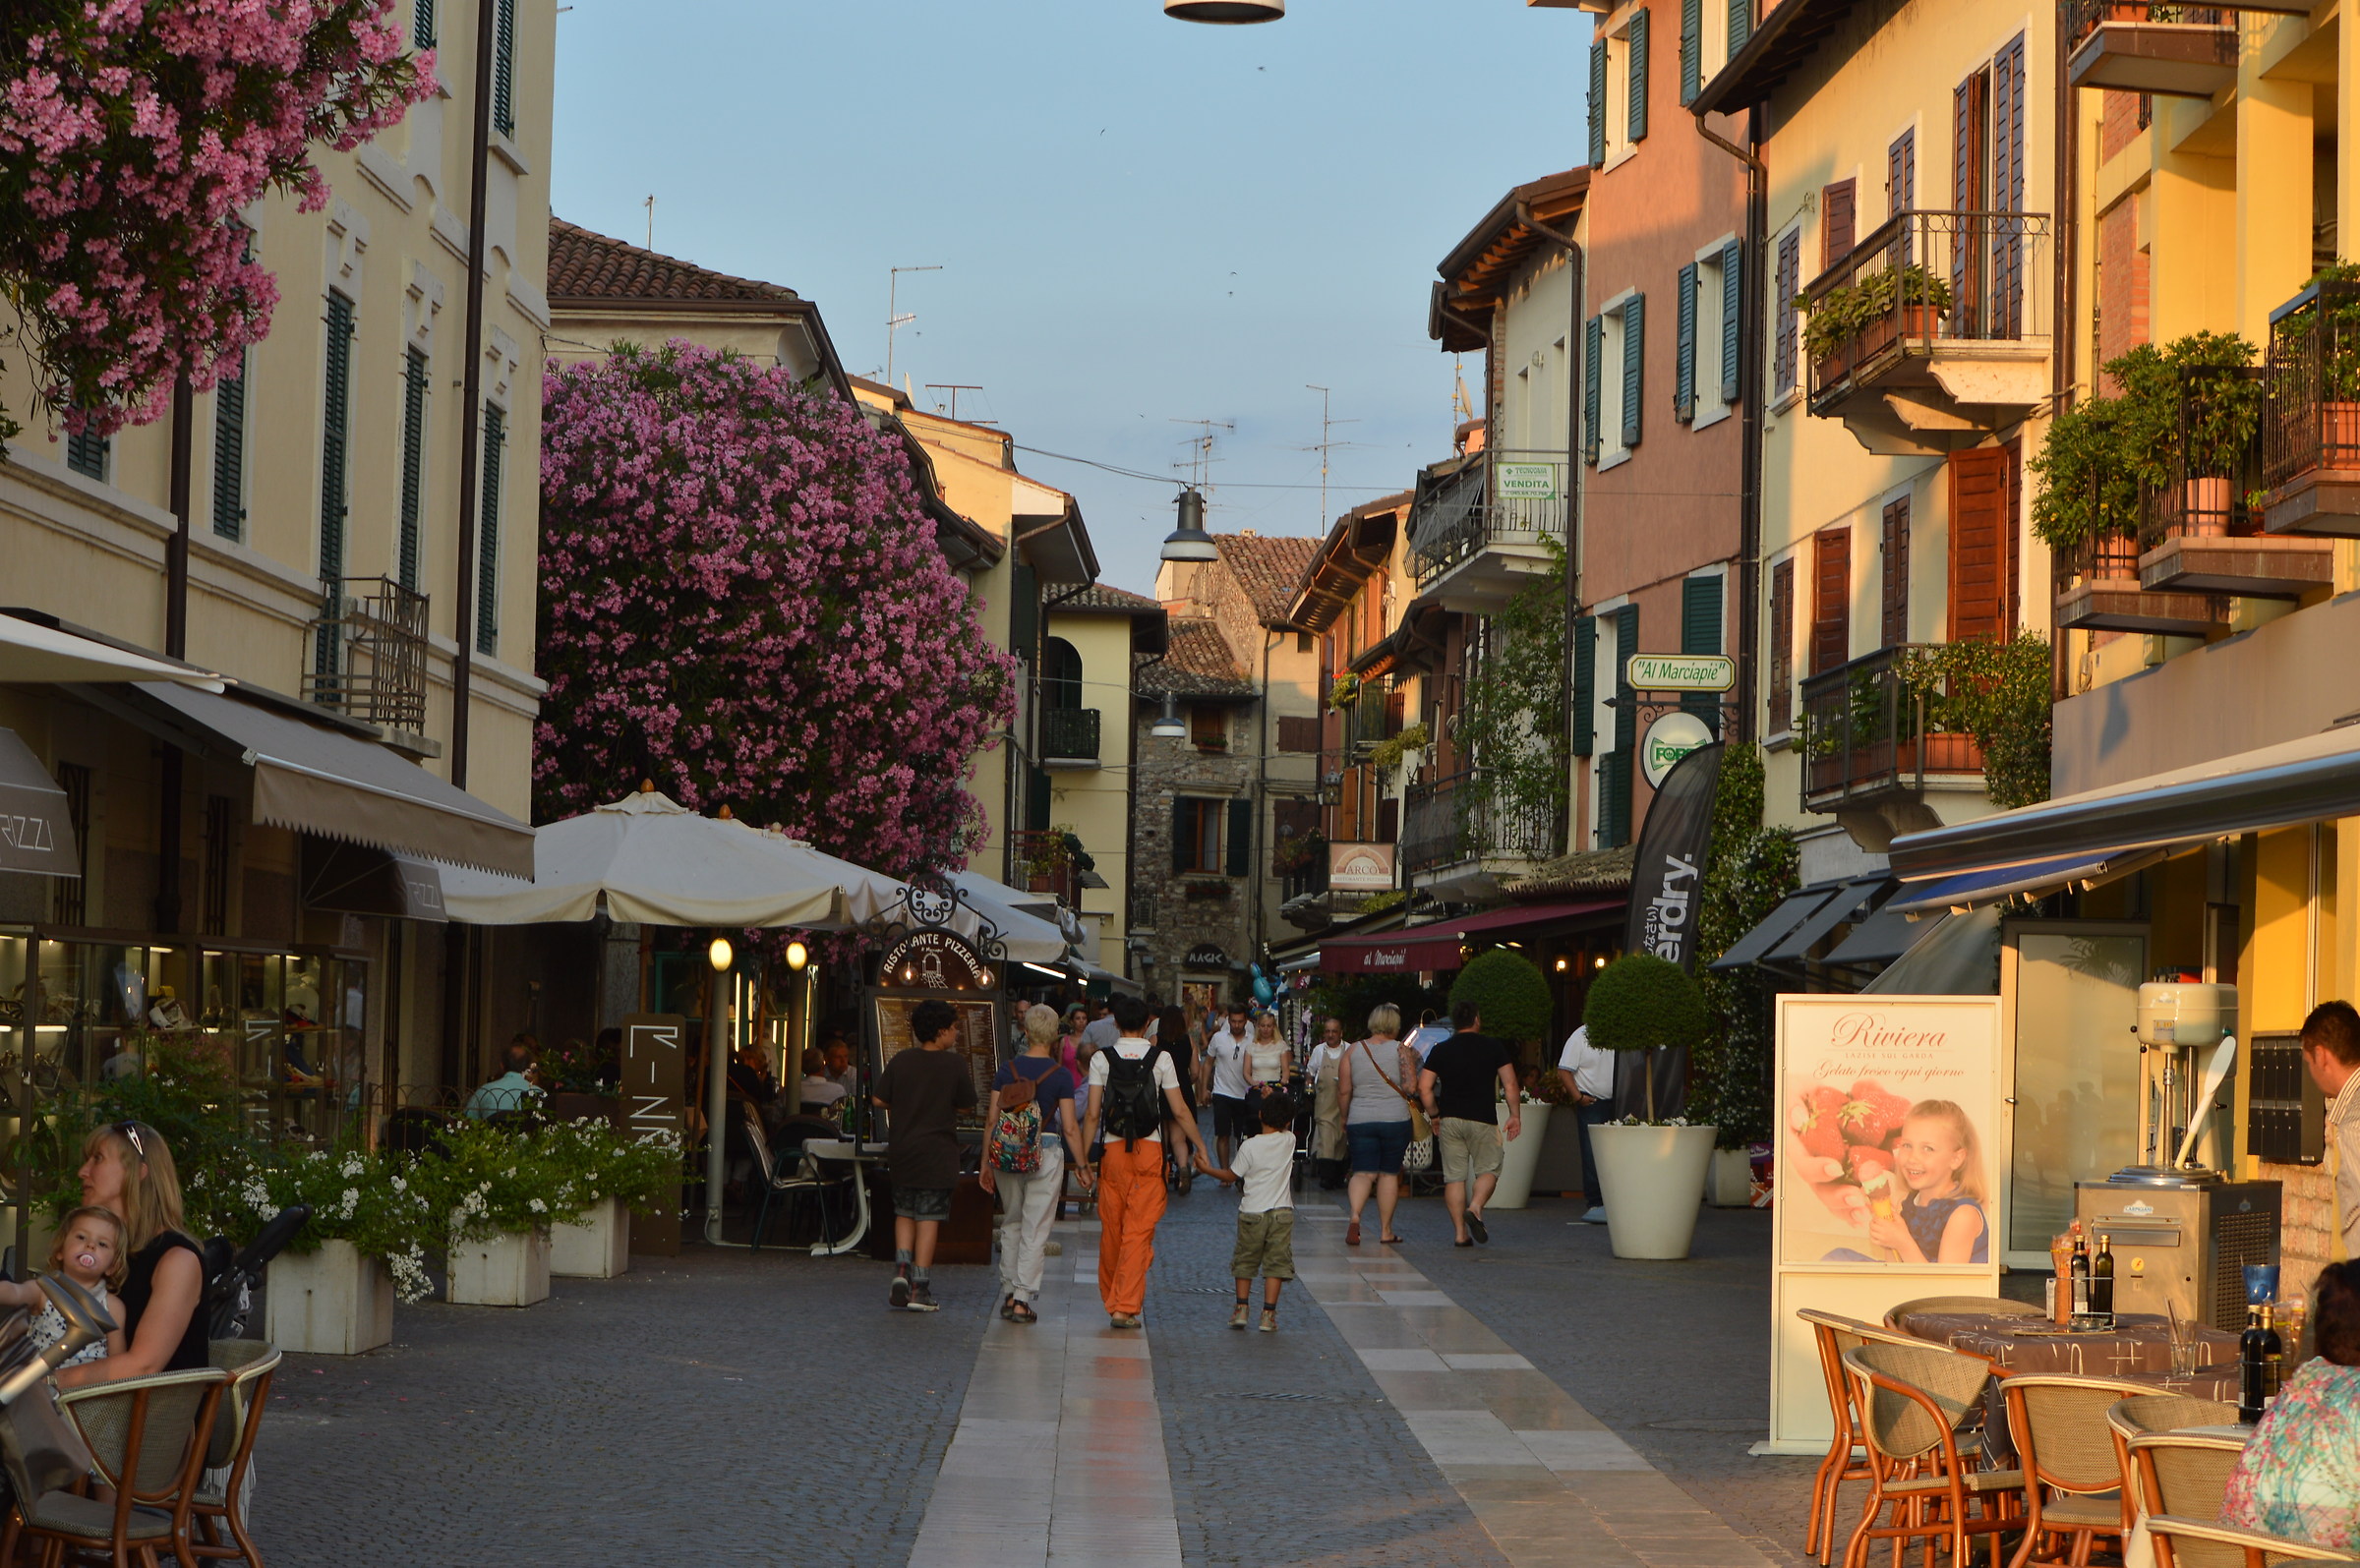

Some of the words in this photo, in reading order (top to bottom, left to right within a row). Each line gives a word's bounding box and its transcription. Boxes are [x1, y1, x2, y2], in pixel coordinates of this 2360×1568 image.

[1346, 865, 1379, 875] ARCO
[883, 933, 939, 974] RISTOANTE
[945, 937, 981, 979] PIZZERIA
[1831, 1013, 1948, 1048] Riviera
[1813, 1059, 1857, 1079] Gelato
[1857, 1064, 1891, 1080] fresco
[1894, 1066, 1923, 1081] ogni
[1924, 1066, 1965, 1082] giorno
